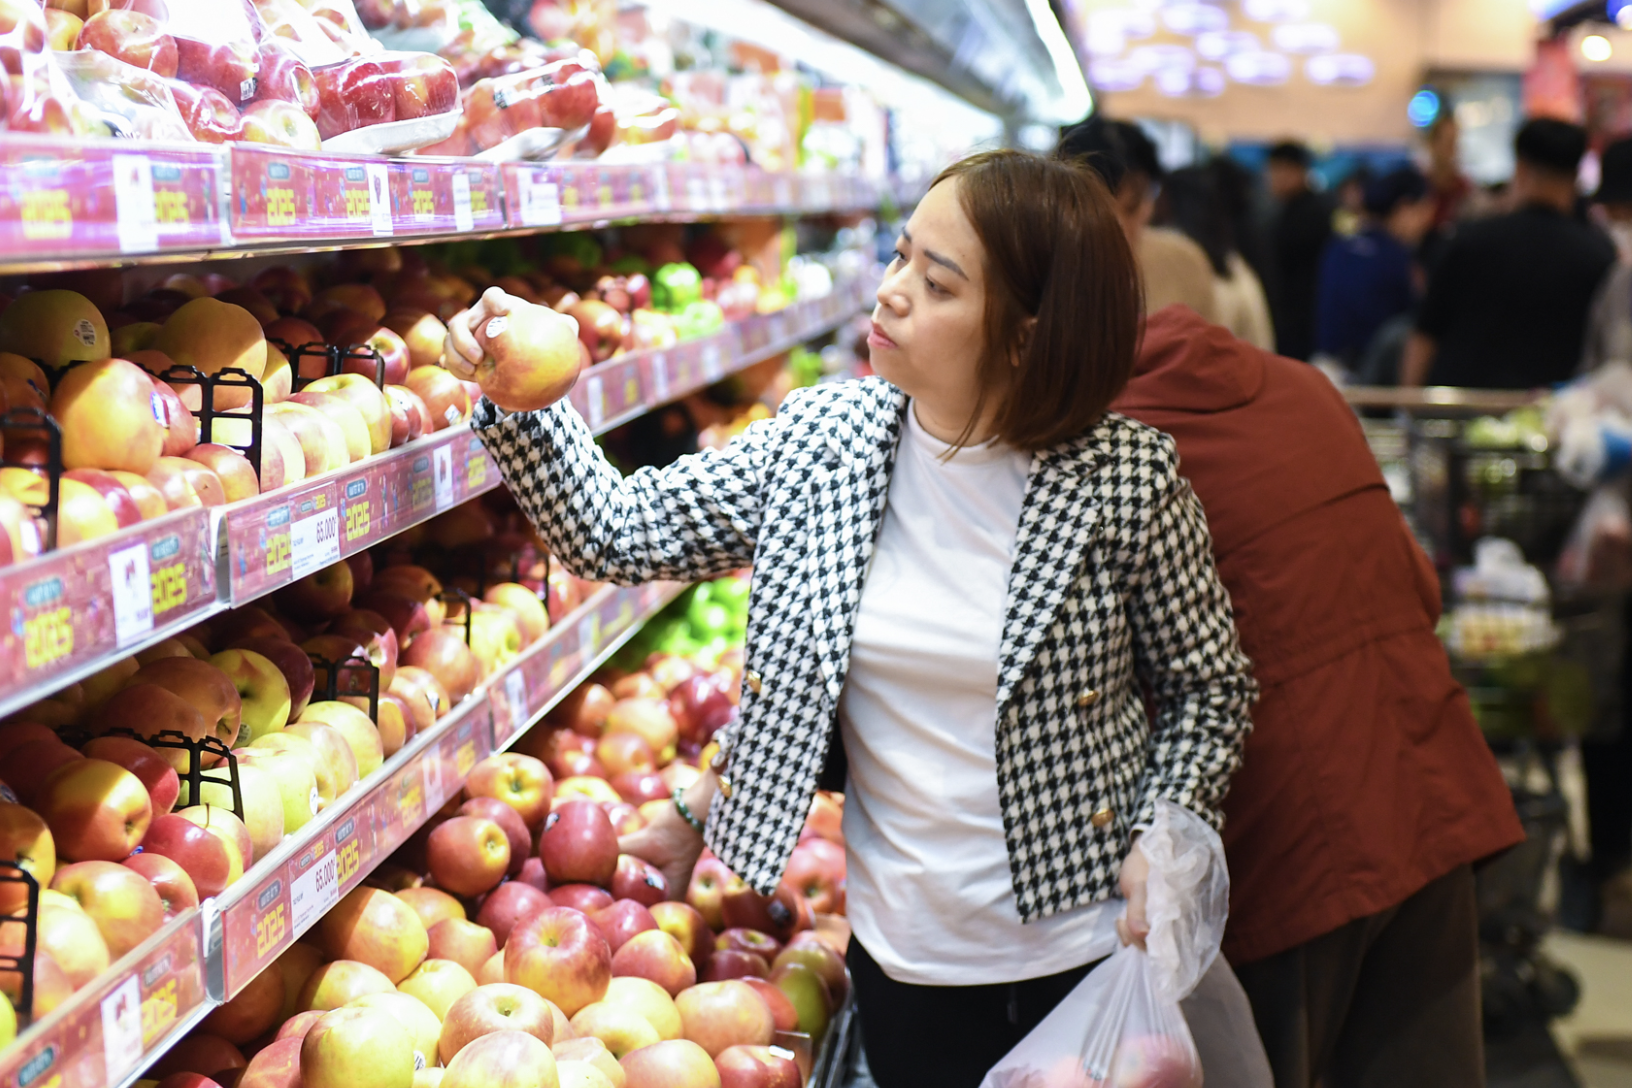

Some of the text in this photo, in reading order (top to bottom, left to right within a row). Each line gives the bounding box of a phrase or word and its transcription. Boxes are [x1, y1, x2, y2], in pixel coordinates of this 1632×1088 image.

[267, 187, 296, 226] 2025
[413, 189, 435, 222] 2025
[346, 501, 370, 541] 2025
[336, 838, 359, 887] 2025
[257, 903, 284, 959] 2025
